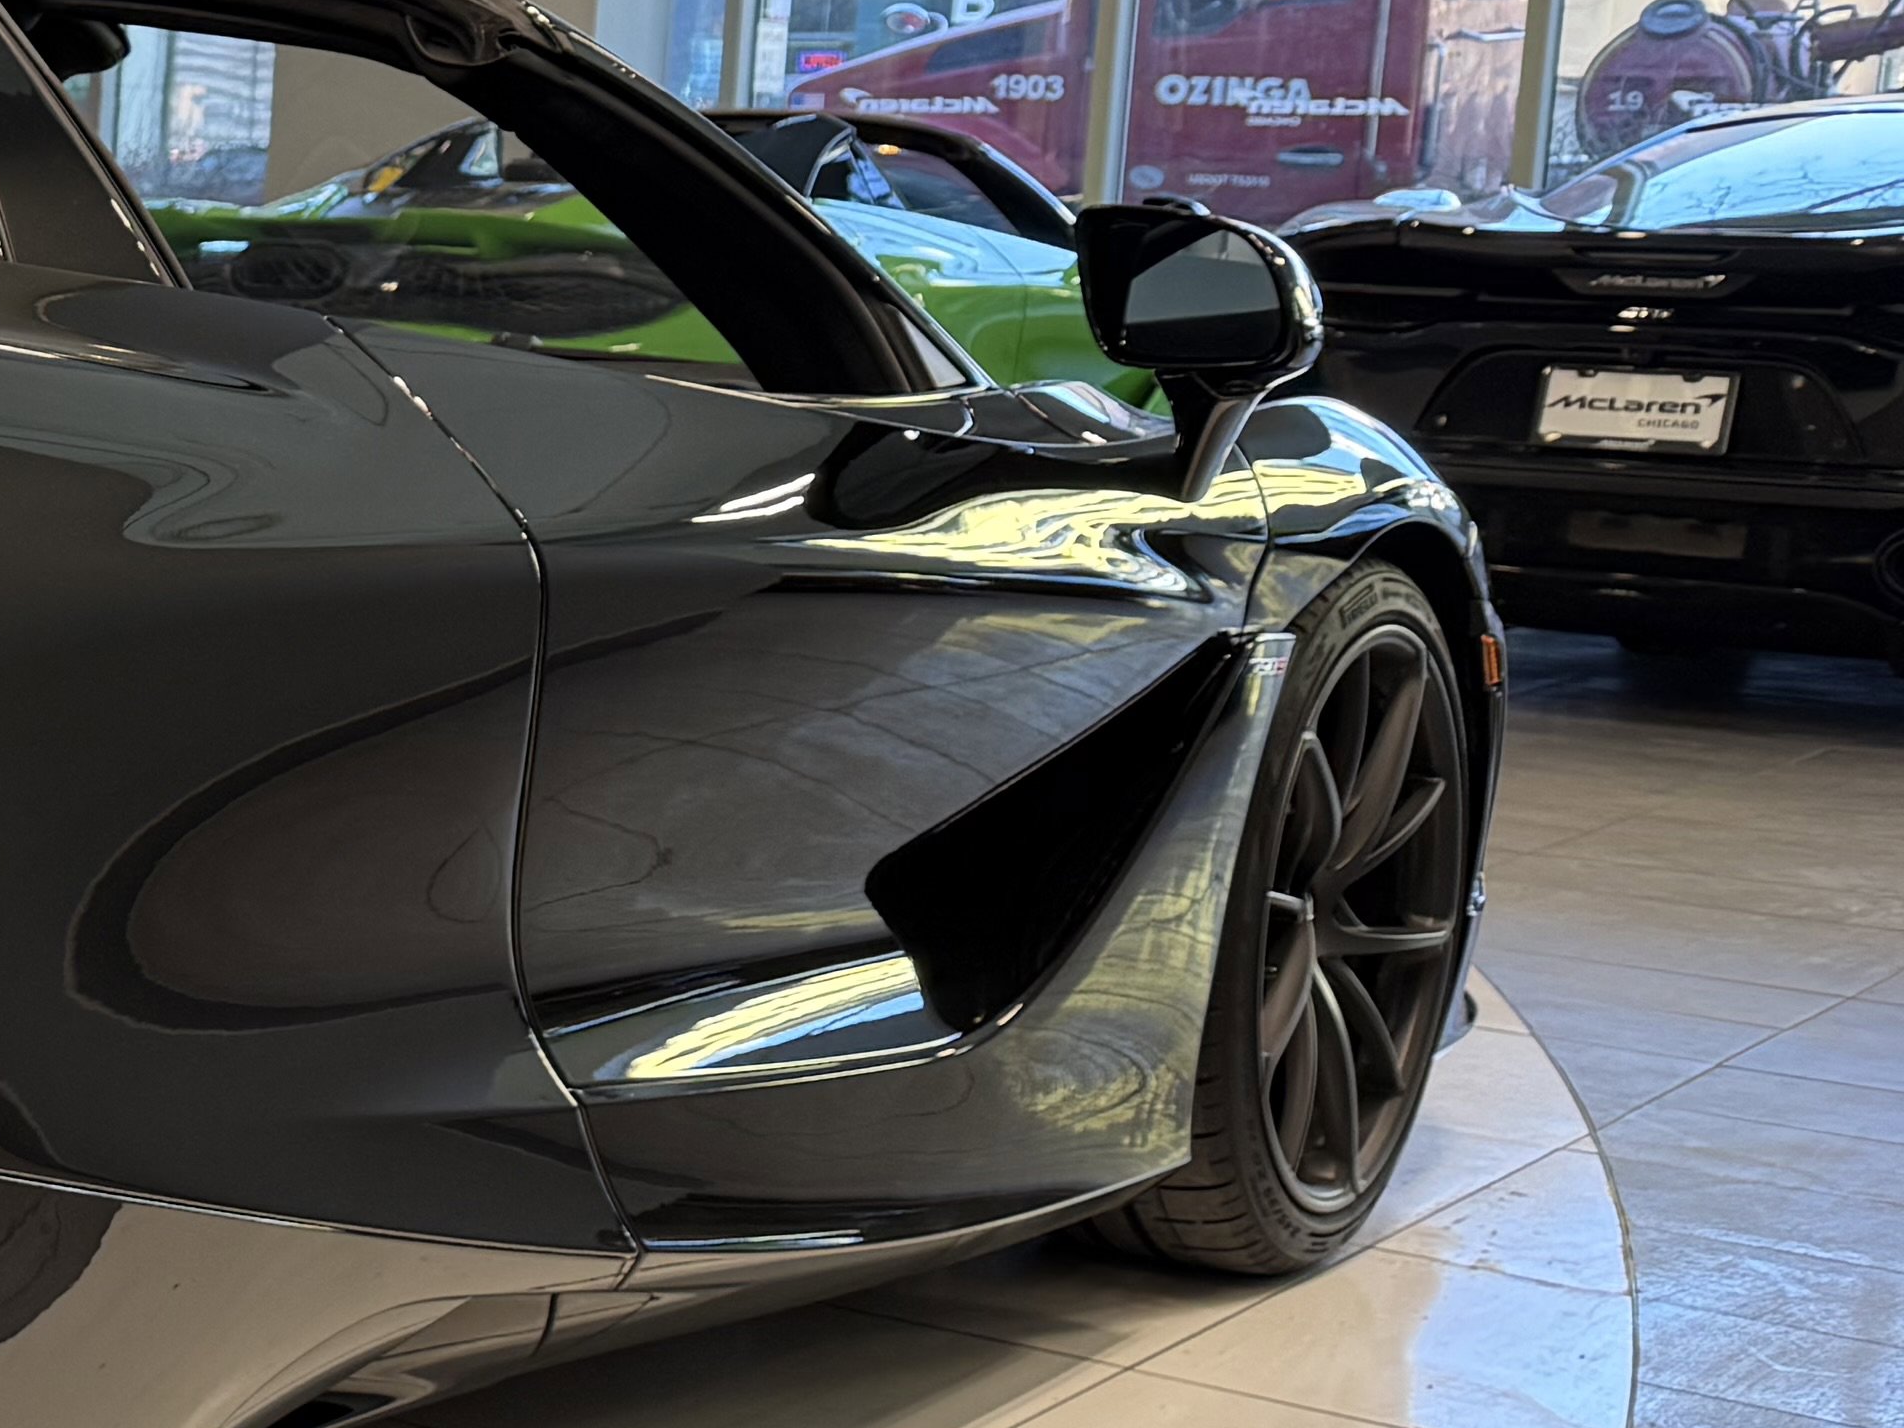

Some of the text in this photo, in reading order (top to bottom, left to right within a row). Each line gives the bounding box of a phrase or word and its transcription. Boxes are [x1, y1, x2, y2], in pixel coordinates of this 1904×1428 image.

[991, 73, 1066, 102] 1903
[1154, 73, 1313, 109] OZINGA
[1547, 394, 1702, 415] McLaren
[1638, 418, 1700, 430] CHICAGO
